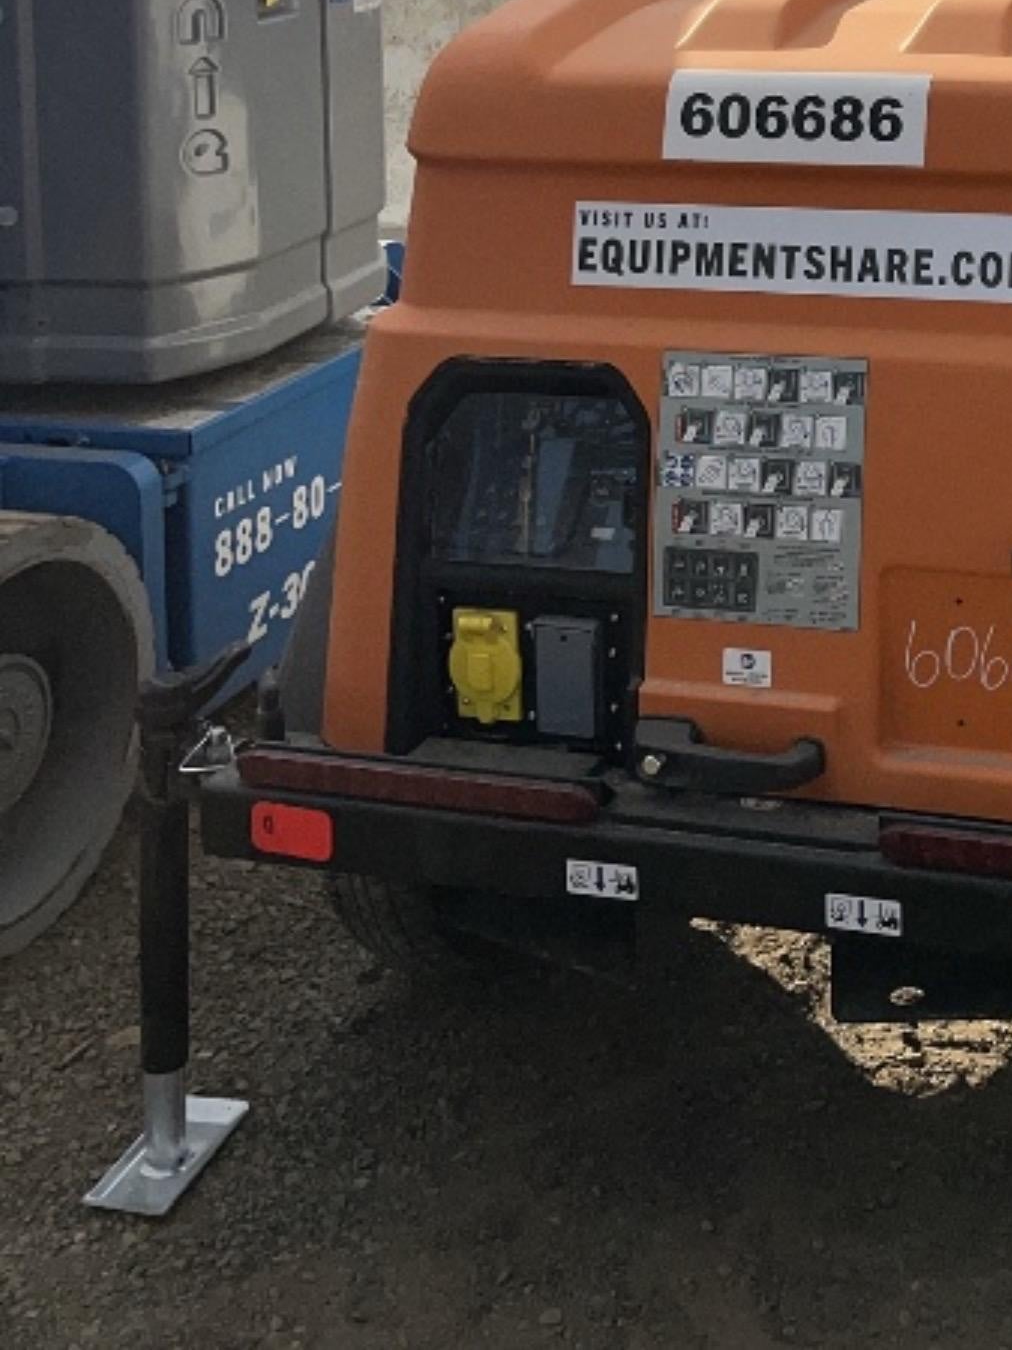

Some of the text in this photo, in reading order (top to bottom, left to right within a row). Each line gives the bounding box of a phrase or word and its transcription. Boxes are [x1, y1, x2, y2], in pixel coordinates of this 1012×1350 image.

[680, 91, 904, 142] 606686
[579, 209, 633, 229] VISIT
[644, 211, 668, 230] US
[214, 455, 299, 518] CALL NOW
